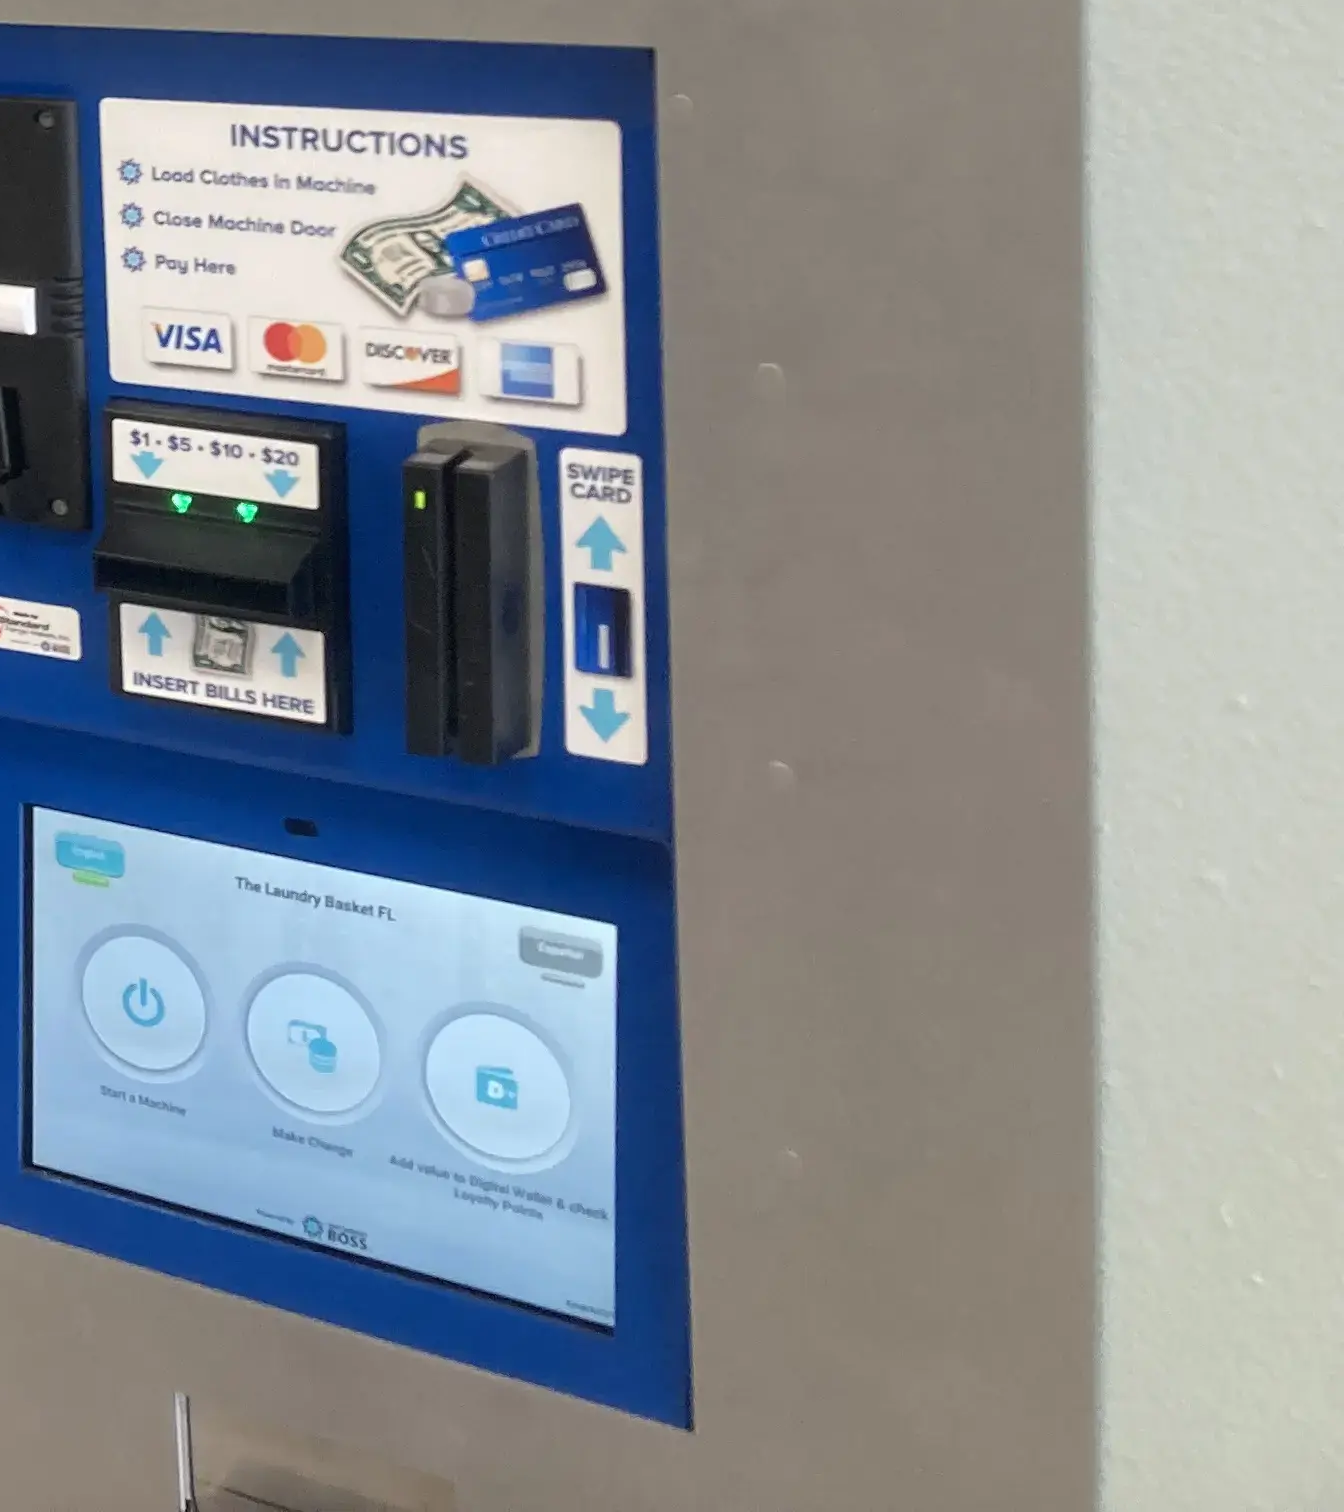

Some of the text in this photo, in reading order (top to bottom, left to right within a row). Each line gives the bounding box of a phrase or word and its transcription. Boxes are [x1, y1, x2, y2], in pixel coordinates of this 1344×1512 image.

[230, 124, 469, 159] INSTRUCTIONS
[151, 166, 377, 196] Load Clothes in Machine
[153, 210, 336, 238] Close Machine Door
[155, 255, 236, 276] Pay Here
[151, 322, 223, 354] VISA
[365, 342, 453, 365] DISCOVER
[129, 428, 299, 467] $1 $5 $10 $20
[567, 462, 635, 486] SWIPE
[569, 481, 633, 504] CARD
[133, 670, 315, 715] INSERT BILLS HERE
[235, 875, 397, 922] The Laundry Basket FL
[138, 1093, 187, 1117] Machine
